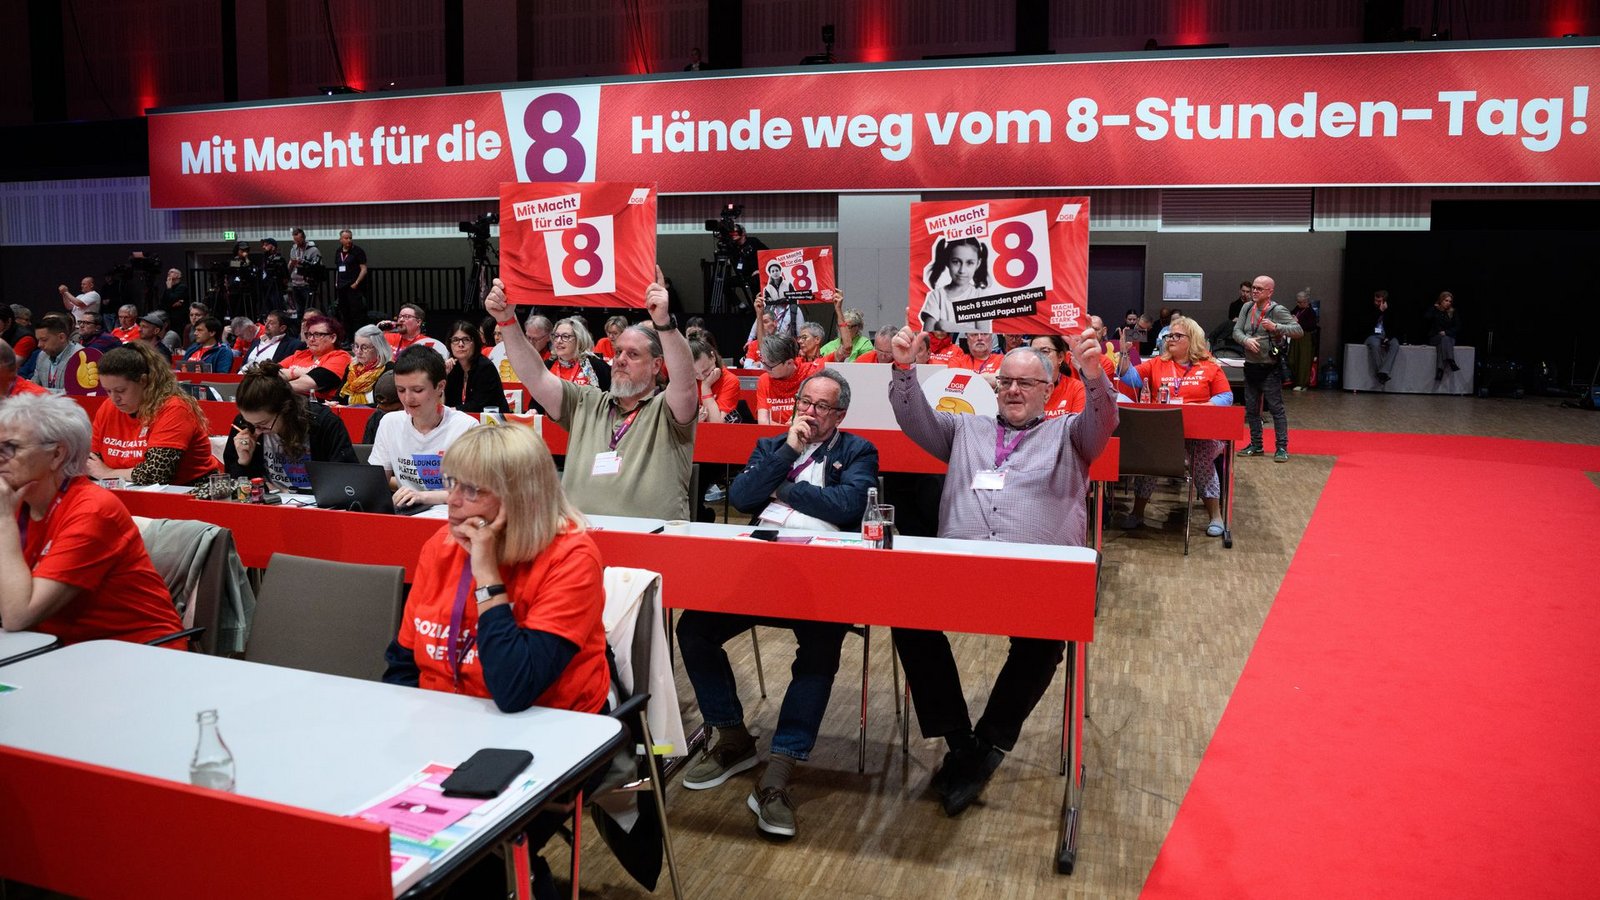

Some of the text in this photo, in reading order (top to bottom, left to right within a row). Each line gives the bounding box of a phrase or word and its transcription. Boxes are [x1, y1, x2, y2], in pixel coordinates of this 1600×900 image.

[631, 86, 1590, 162] Hände weg vom 8-Stunden-Tag!
[181, 92, 587, 182] Mit Macht für die 8
[516, 197, 577, 218] Mit Macht
[534, 215, 574, 229] für die
[928, 207, 986, 231] Mit Macht
[946, 224, 984, 240] für die
[561, 222, 604, 289] 8
[990, 221, 1039, 289] 8
[790, 264, 812, 291] 8
[956, 291, 1044, 312] Nach 8 Stunden gehören
[957, 304, 1032, 321] Mama und Papa mir!
[1056, 309, 1079, 317] DICH
